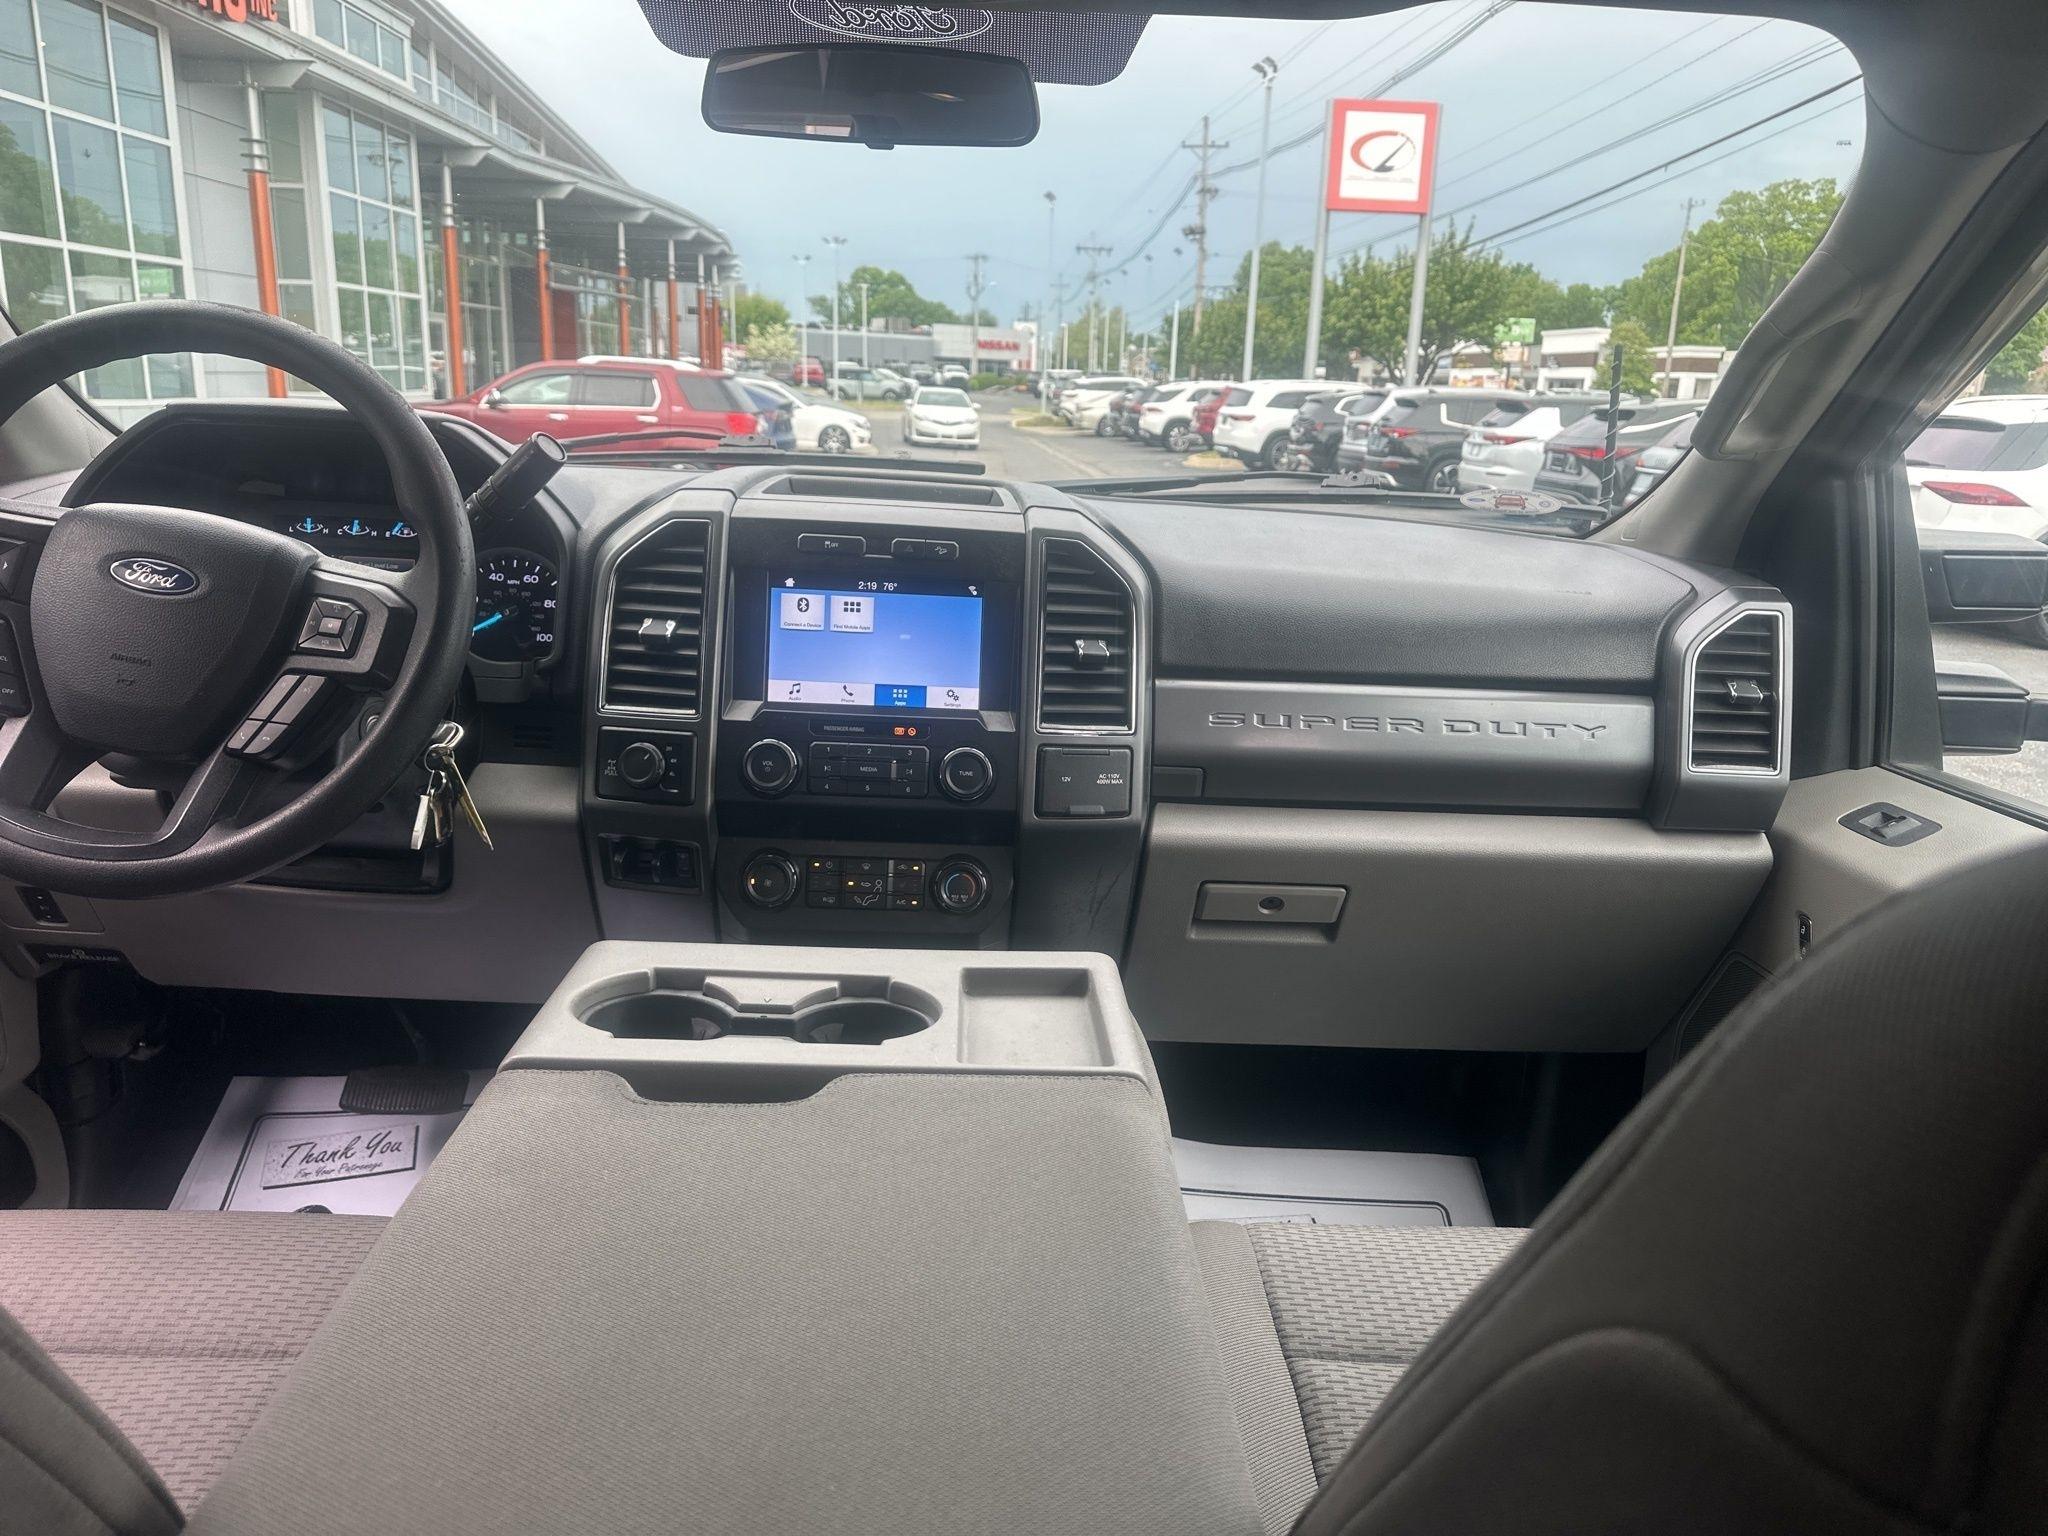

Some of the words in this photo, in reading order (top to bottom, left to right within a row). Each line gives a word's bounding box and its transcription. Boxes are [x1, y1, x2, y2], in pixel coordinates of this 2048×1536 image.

[124, 562, 179, 588] Ford
[488, 573, 504, 582] 40
[523, 575, 539, 583] 60
[858, 581, 878, 590] 2:19
[883, 582, 898, 591] 76°
[536, 633, 553, 642] 100
[1208, 711, 1425, 734] SUPER
[1442, 719, 1607, 741] DUTY
[281, 1136, 362, 1168] Thank
[366, 1130, 402, 1158] You
[293, 1167, 312, 1179] For
[315, 1167, 336, 1177] Your
